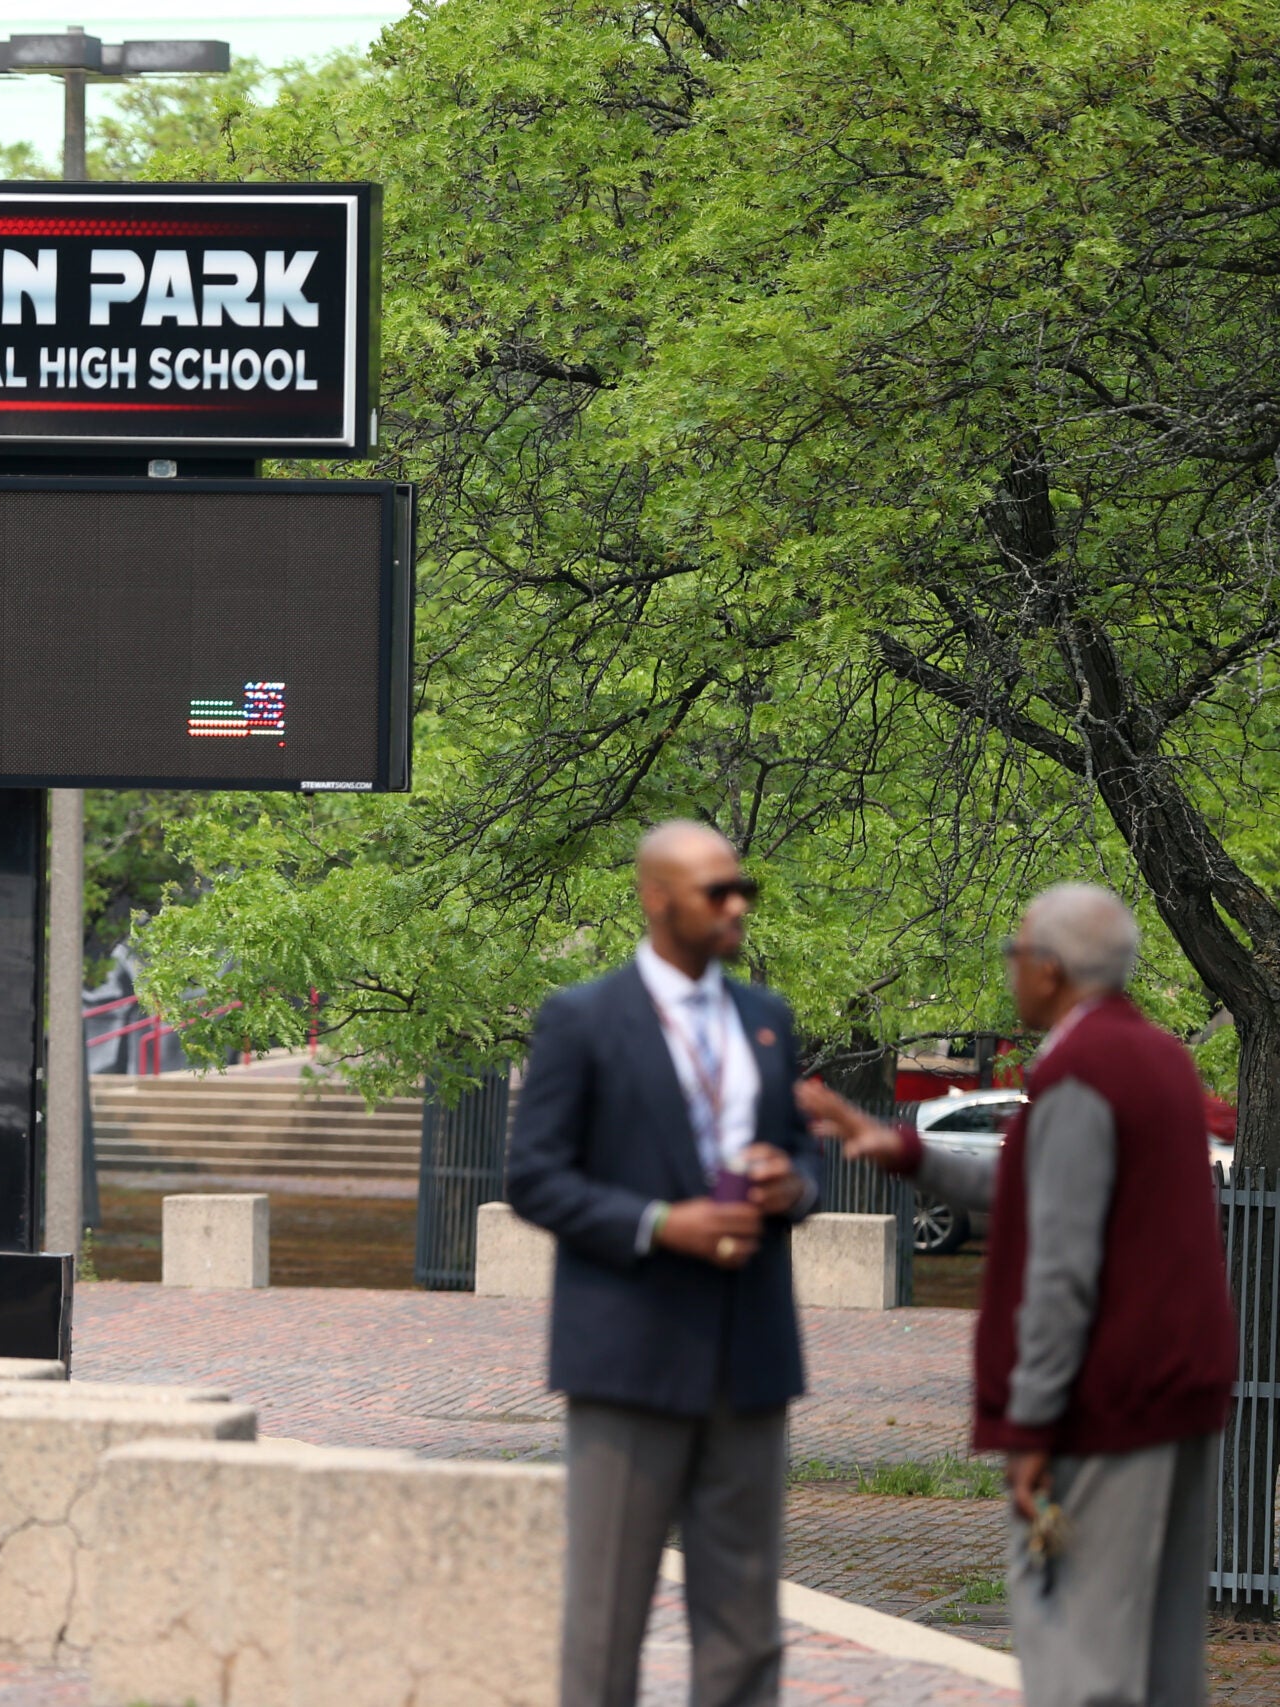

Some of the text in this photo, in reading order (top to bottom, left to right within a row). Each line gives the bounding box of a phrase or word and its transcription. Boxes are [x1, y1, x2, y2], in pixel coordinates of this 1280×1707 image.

[89, 248, 320, 328] PARK
[39, 346, 137, 390] HIGH
[148, 348, 318, 392] SCHOOL
[301, 781, 373, 790] STEWARTSIGNS.COM
